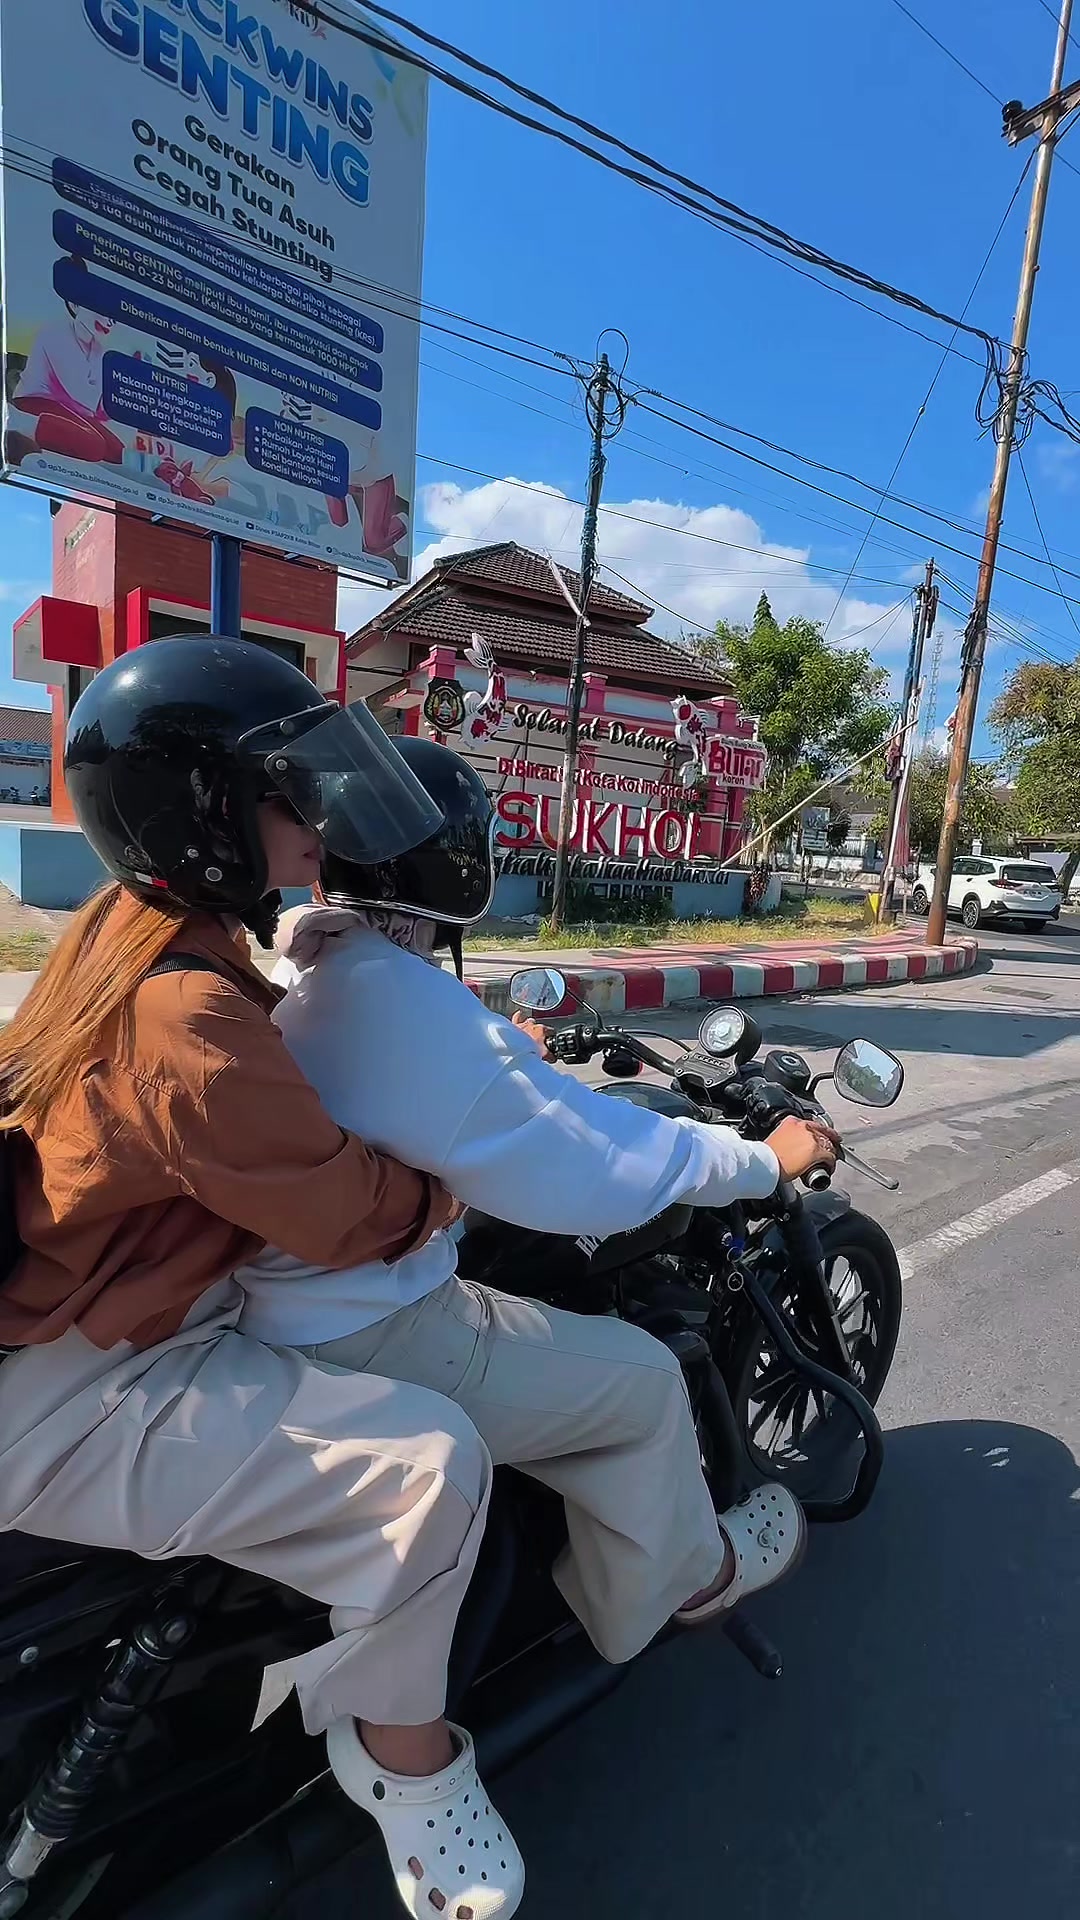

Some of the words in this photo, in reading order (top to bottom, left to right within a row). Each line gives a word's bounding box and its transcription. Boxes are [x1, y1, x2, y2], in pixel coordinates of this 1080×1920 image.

[82, 0, 371, 204] GENTING
[184, 115, 296, 198] Gerakan
[131, 118, 221, 191] Orang
[227, 171, 273, 216] Tua
[278, 204, 335, 251] Asuh
[134, 153, 225, 221] Cegah
[231, 207, 333, 283] Stunting
[102, 203, 122, 219] tua
[124, 212, 152, 233] asuh
[154, 227, 185, 249] untuk
[186, 243, 241, 277] membantu
[242, 271, 283, 299] keluarga
[285, 292, 319, 316] berisiko
[320, 312, 353, 337] stunting
[75, 223, 131, 257] Penerima
[132, 251, 183, 281] GENTING
[185, 276, 226, 302] meliputi
[226, 294, 243, 310] ibu
[244, 303, 273, 326] hamil,
[273, 318, 289, 333] ibu
[289, 327, 331, 353] menyusui
[331, 345, 348, 361] dan
[349, 355, 369, 371] anak
[93, 244, 135, 272] baduta
[138, 265, 165, 286] 0-23
[201, 293, 248, 325] (Keluarga
[249, 319, 274, 338] yang
[275, 329, 316, 357] termasuk
[317, 349, 338, 366] 1000
[339, 360, 358, 377] HPK)
[260, 268, 301, 296] berbagai
[303, 291, 327, 310] pihak
[328, 304, 361, 328] sebagai
[120, 299, 169, 329] Diberikan
[171, 321, 202, 343] dalam
[203, 335, 235, 357] bentuk
[236, 351, 271, 373] NUTRISI
[271, 367, 289, 381] dan
[289, 374, 308, 390] NON
[309, 382, 339, 403] NUTRISI
[112, 369, 160, 396] Makanan
[162, 388, 201, 412] lengkap
[203, 405, 223, 420] siap
[119, 386, 156, 405] santap
[157, 399, 182, 415] kaya
[183, 409, 217, 428] protein
[151, 370, 189, 394] NUTRISI
[111, 393, 149, 414] hewani
[150, 409, 171, 423] dan
[172, 413, 223, 441] kecukupan
[158, 422, 181, 437] Gizi.
[274, 420, 293, 434] NON
[294, 428, 326, 447] NUTRISI
[261, 426, 303, 449] Perbaikan
[304, 444, 337, 463] Jamban
[261, 437, 291, 455] Rumah
[291, 449, 317, 464] Layak
[317, 458, 334, 472] Huni
[261, 448, 280, 462] Nilai
[281, 456, 316, 475] bantuan
[317, 469, 341, 484] sesuai
[261, 458, 290, 475] kondisi
[291, 470, 323, 487] wilayah
[607, 721, 679, 761] Datang
[495, 791, 701, 861] SUKHOI
